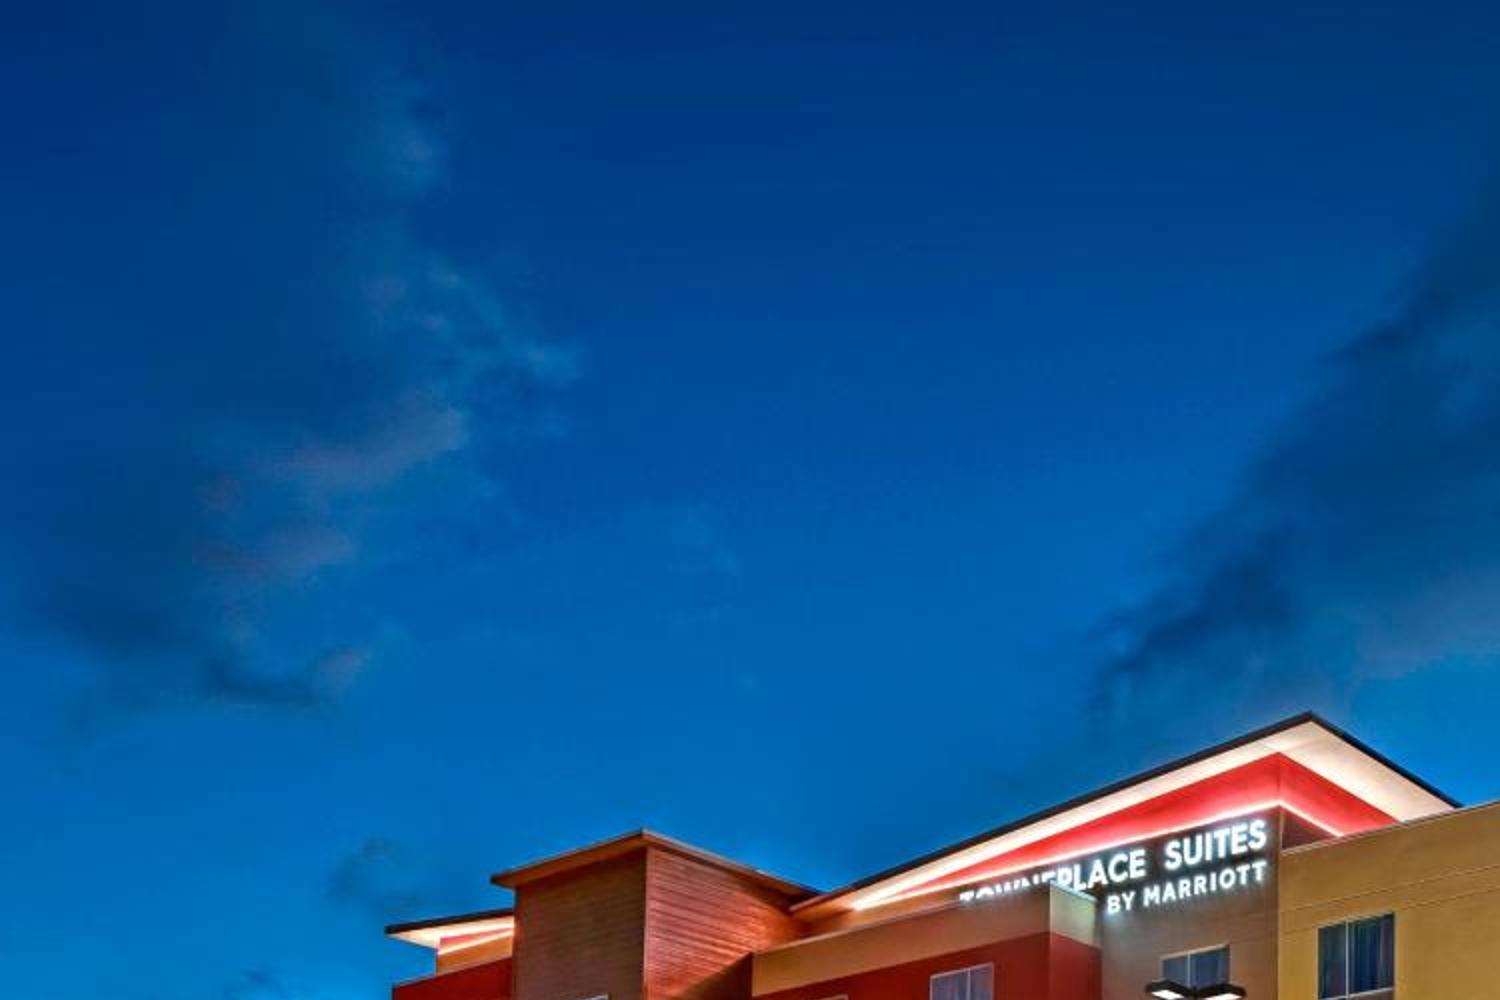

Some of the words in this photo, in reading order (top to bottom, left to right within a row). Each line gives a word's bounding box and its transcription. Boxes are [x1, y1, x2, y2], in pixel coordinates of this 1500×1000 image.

[1164, 820, 1267, 870] SUITES
[1106, 890, 1137, 914] BY
[1143, 861, 1268, 906] MARRIOTT
